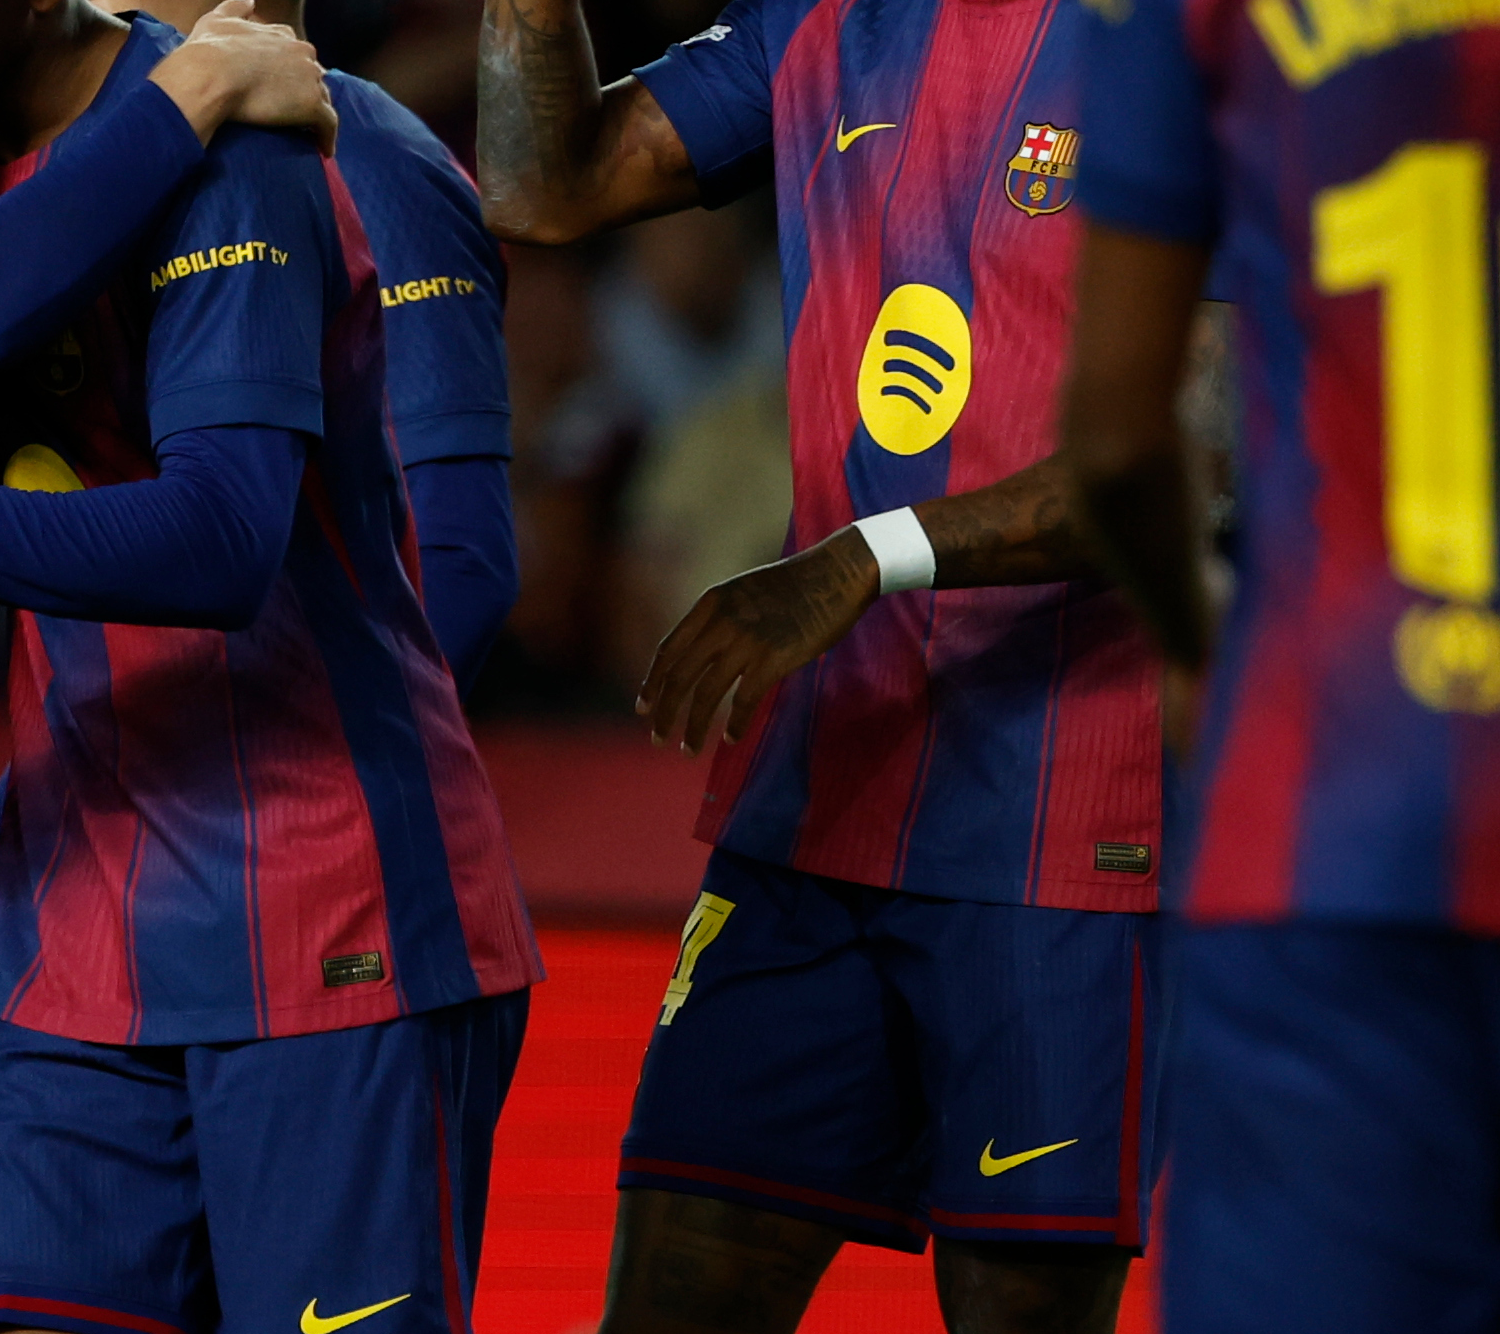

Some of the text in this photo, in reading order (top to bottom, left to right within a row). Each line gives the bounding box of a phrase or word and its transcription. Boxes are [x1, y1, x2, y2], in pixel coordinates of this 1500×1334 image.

[1030, 160, 1059, 175] FCB
[151, 241, 289, 293] AMBILIGHT tv
[380, 276, 451, 309] LIGHT
